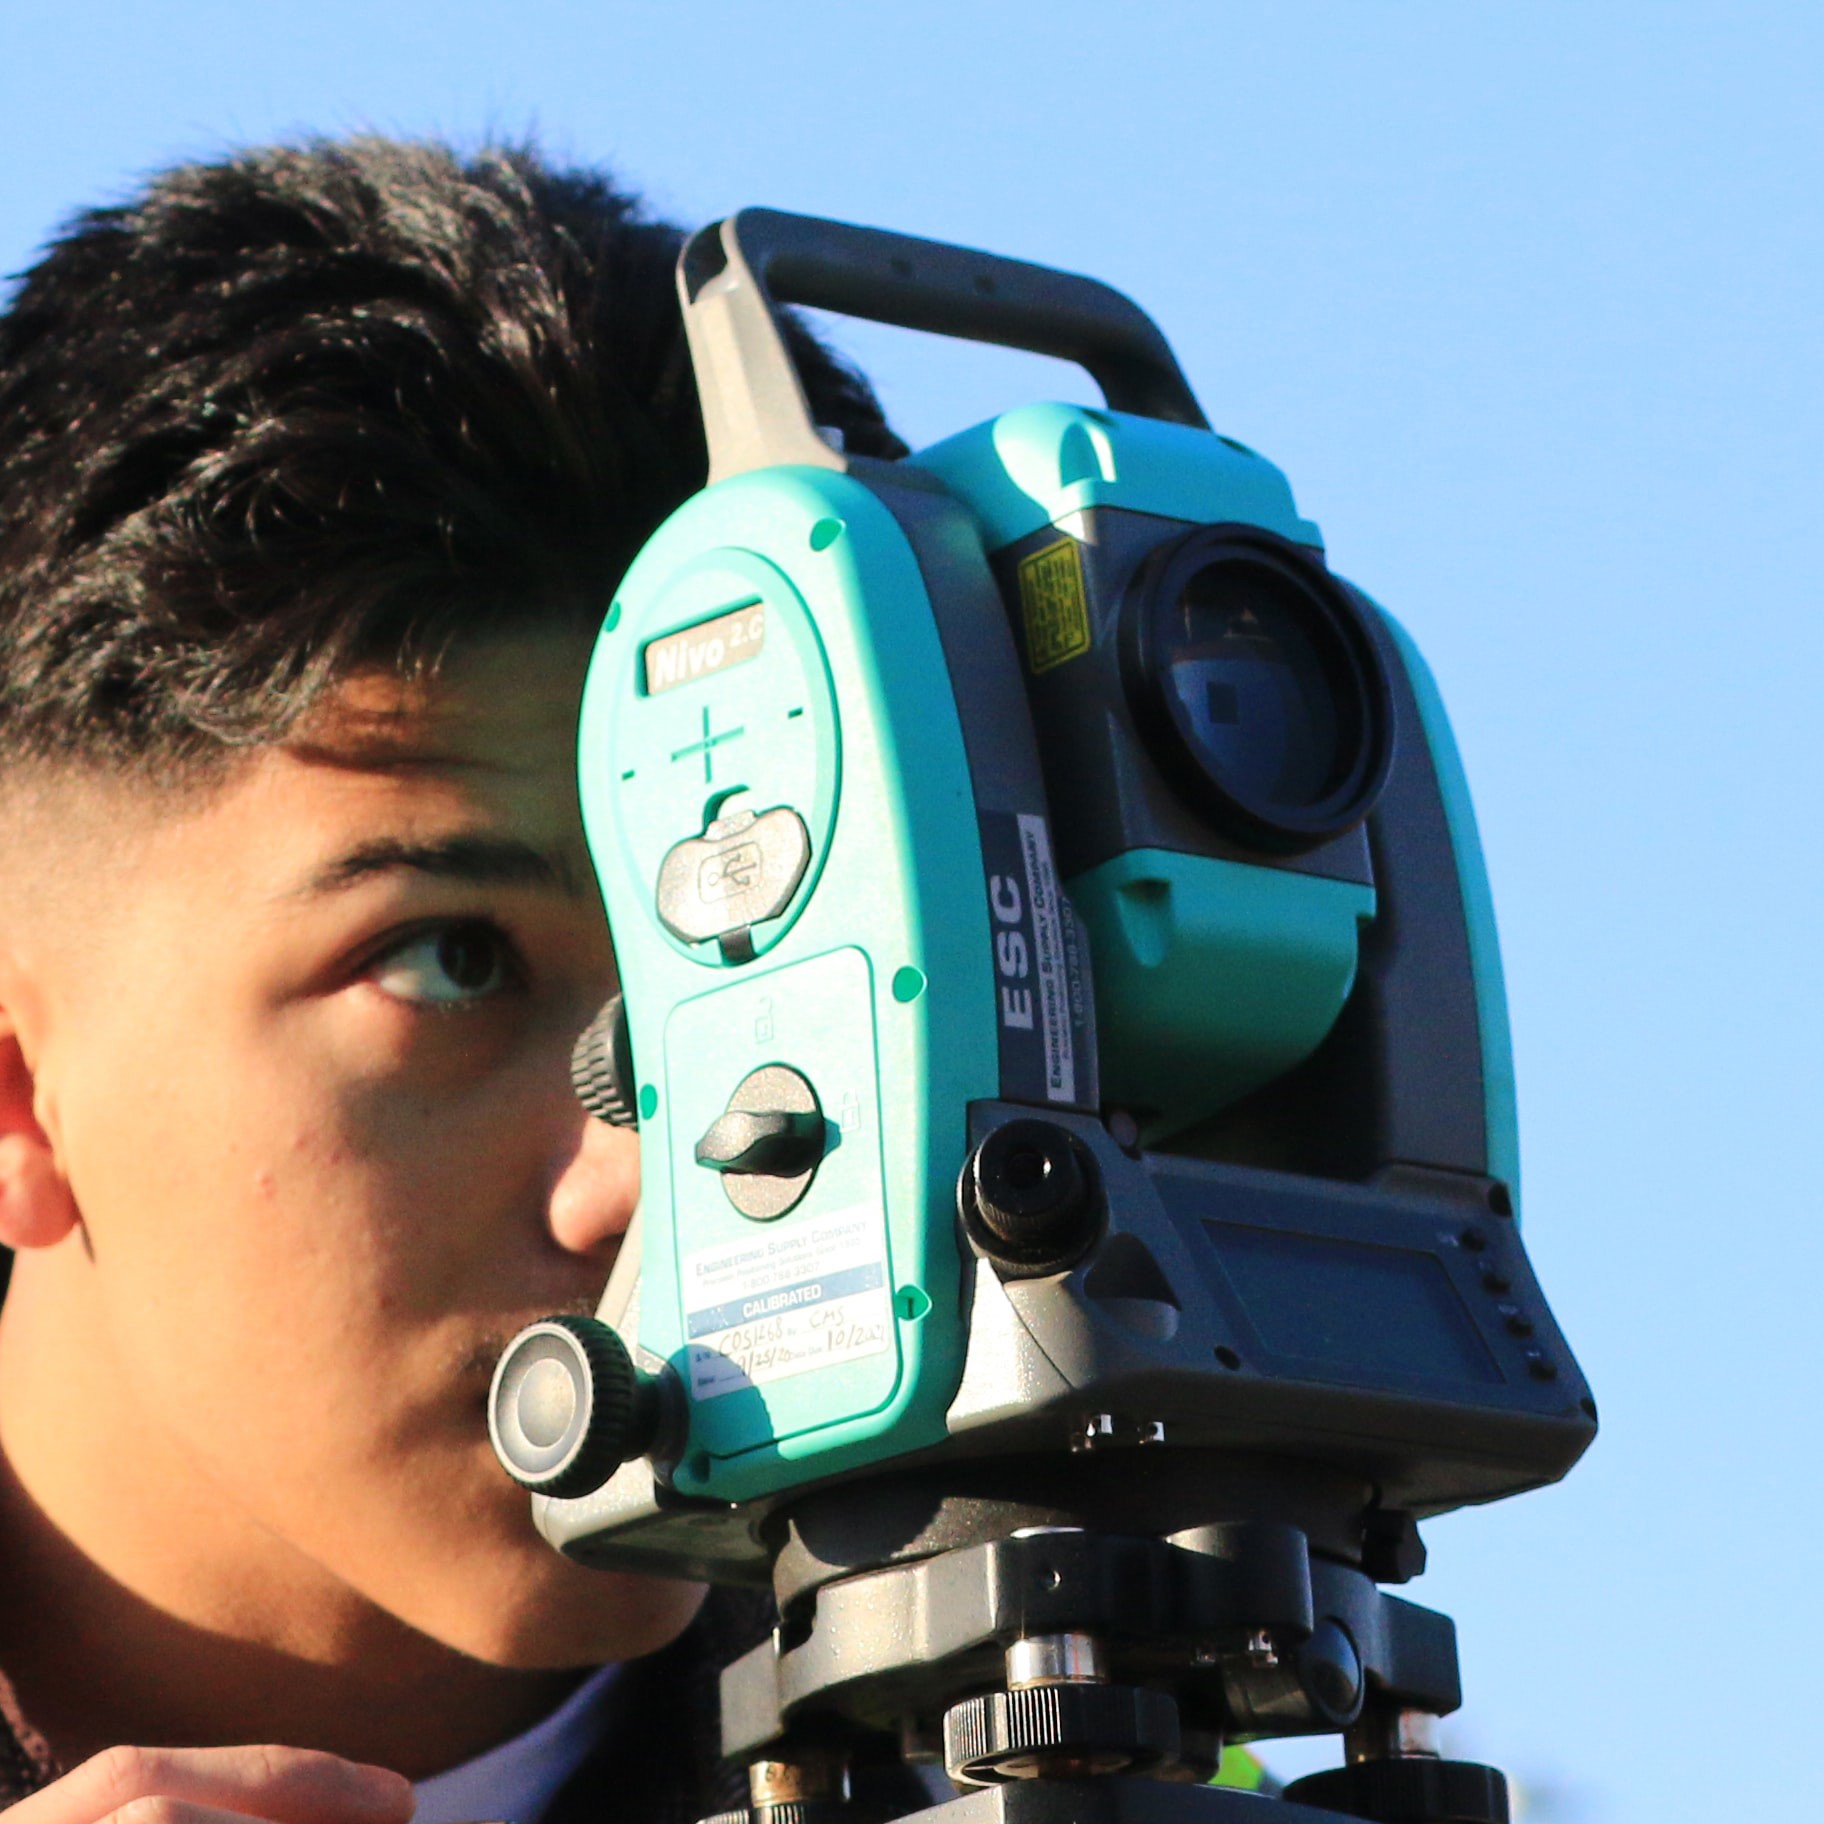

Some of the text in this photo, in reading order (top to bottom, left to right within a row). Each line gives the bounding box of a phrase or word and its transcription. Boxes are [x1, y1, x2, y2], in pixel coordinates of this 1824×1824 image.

[654, 637, 725, 688] Nivo
[1026, 831, 1045, 909] COMPANY
[990, 875, 1034, 1030] ESC
[1036, 915, 1053, 974] SUPPLY
[1042, 979, 1062, 1090] ENGINEERING
[695, 1251, 765, 1277] ENGINEERING
[768, 1238, 808, 1256] SUPPLY
[811, 1221, 867, 1244] COMPANY
[743, 1284, 821, 1318] CALIBRATED
